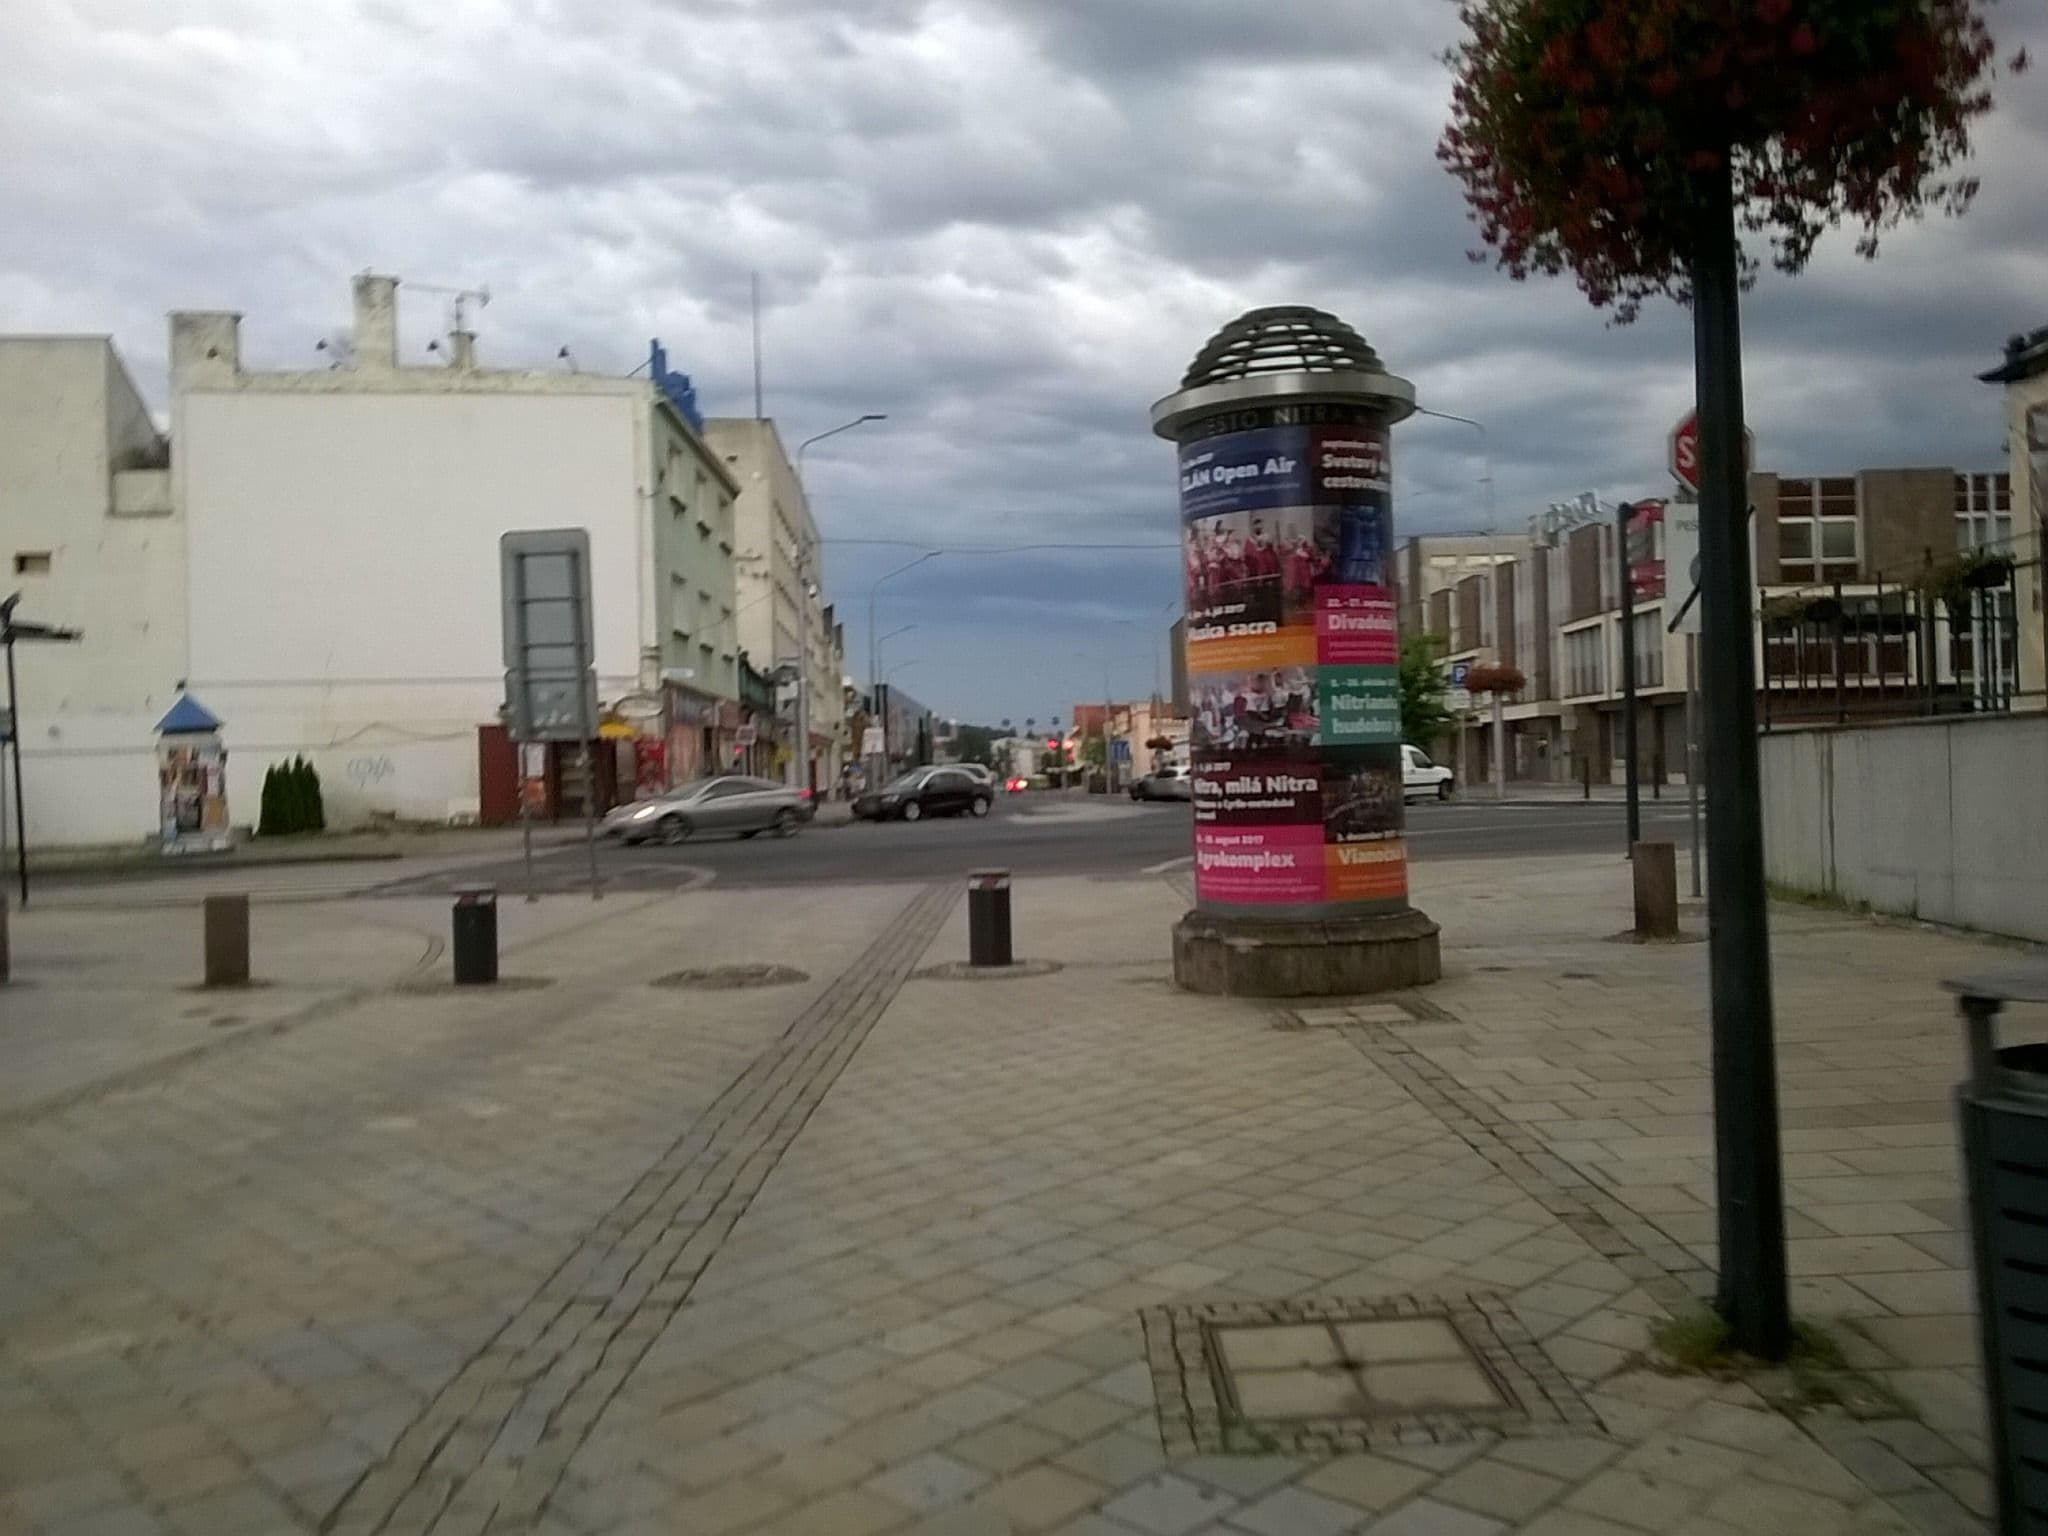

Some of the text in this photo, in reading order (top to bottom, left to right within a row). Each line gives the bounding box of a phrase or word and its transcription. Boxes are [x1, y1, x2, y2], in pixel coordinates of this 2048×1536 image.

[1213, 464, 1259, 485] Open
[1263, 456, 1297, 475] Air
[1227, 620, 1278, 637] sacra
[1224, 775, 1262, 795] milá
[1266, 774, 1319, 793] Nitra
